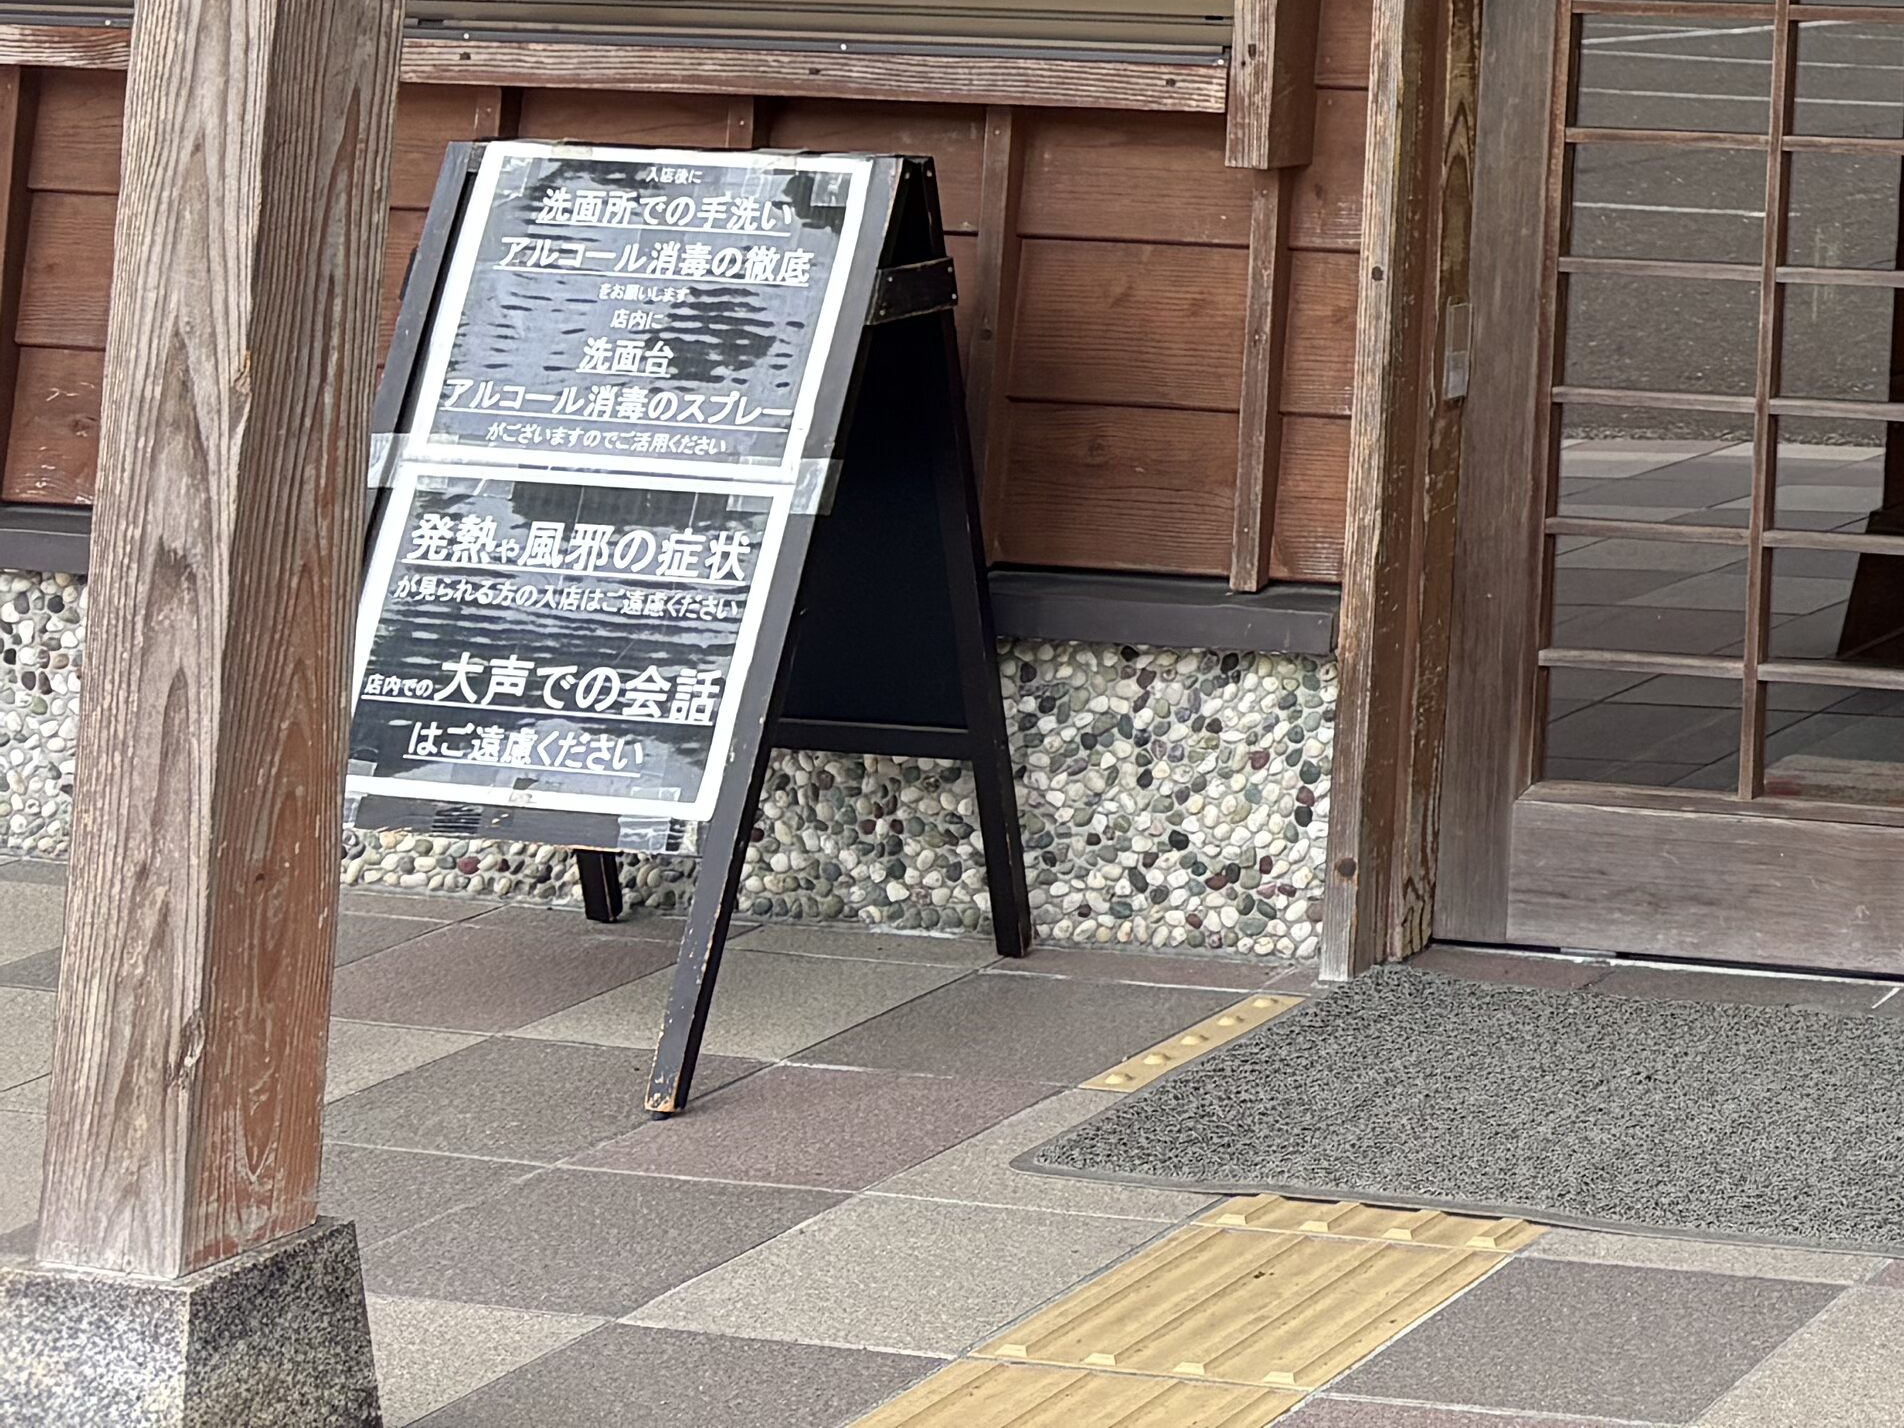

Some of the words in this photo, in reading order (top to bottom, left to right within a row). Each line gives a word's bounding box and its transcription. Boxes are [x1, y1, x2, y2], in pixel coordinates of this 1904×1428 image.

[646, 167, 701, 185] 入店後に
[535, 187, 793, 231] 洗面所での手洗い
[497, 235, 815, 282] アルコール消毒の徹底
[610, 309, 665, 329] 店内に
[580, 337, 675, 374] 洗面台
[440, 378, 794, 425] アルコール消毒のスプレー
[487, 422, 727, 455] がございますのでご活用ください
[410, 513, 752, 581] 発熱や風邪の症状
[394, 576, 738, 621] が見られる方の入店はご遠慮ください
[365, 652, 725, 725] 店内での大声での会話
[408, 721, 644, 771] はご遠慮ください
